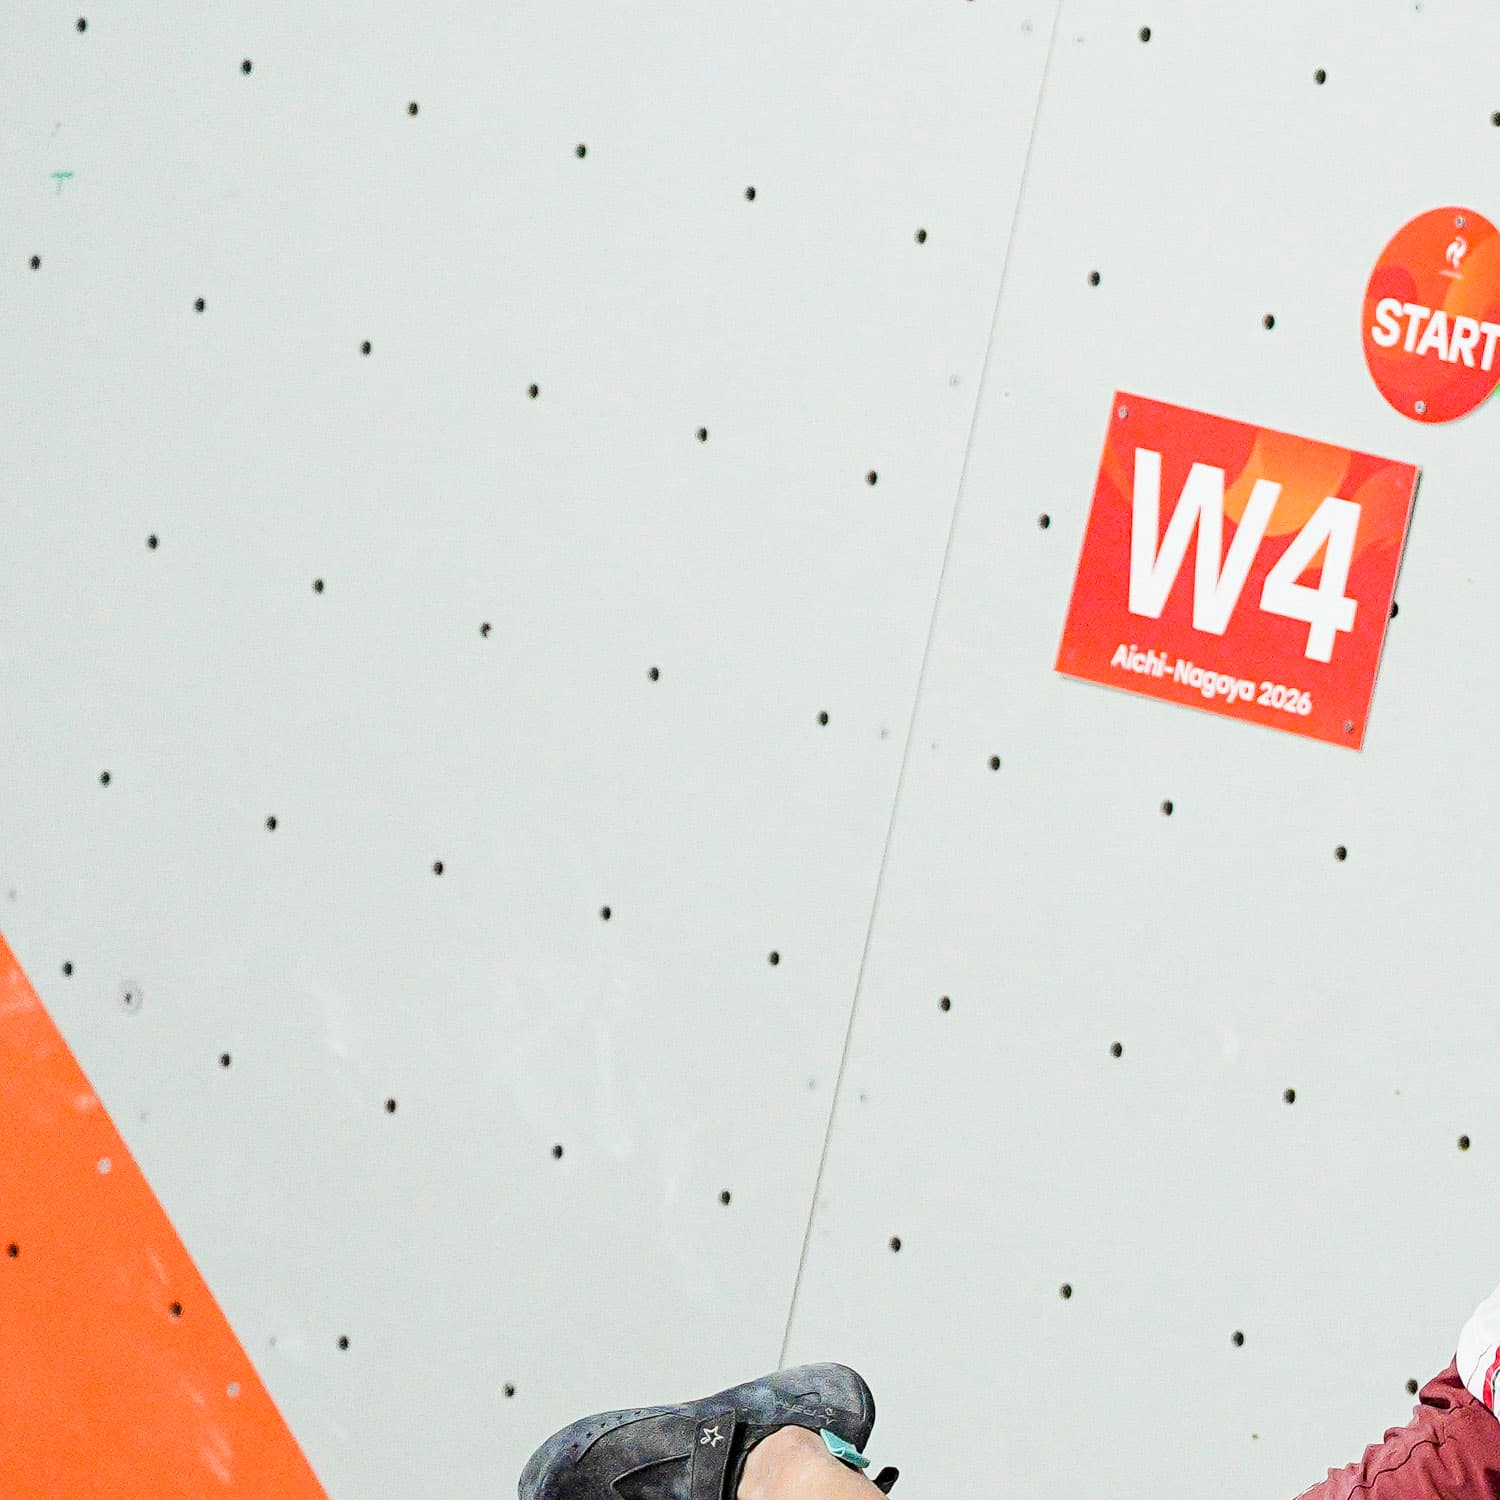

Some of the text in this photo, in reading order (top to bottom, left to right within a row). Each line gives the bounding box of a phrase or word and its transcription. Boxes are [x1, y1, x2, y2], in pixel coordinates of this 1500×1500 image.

[1127, 447, 1362, 664] W4
[1110, 643, 1313, 717] Aichi-Nagoya 2026
